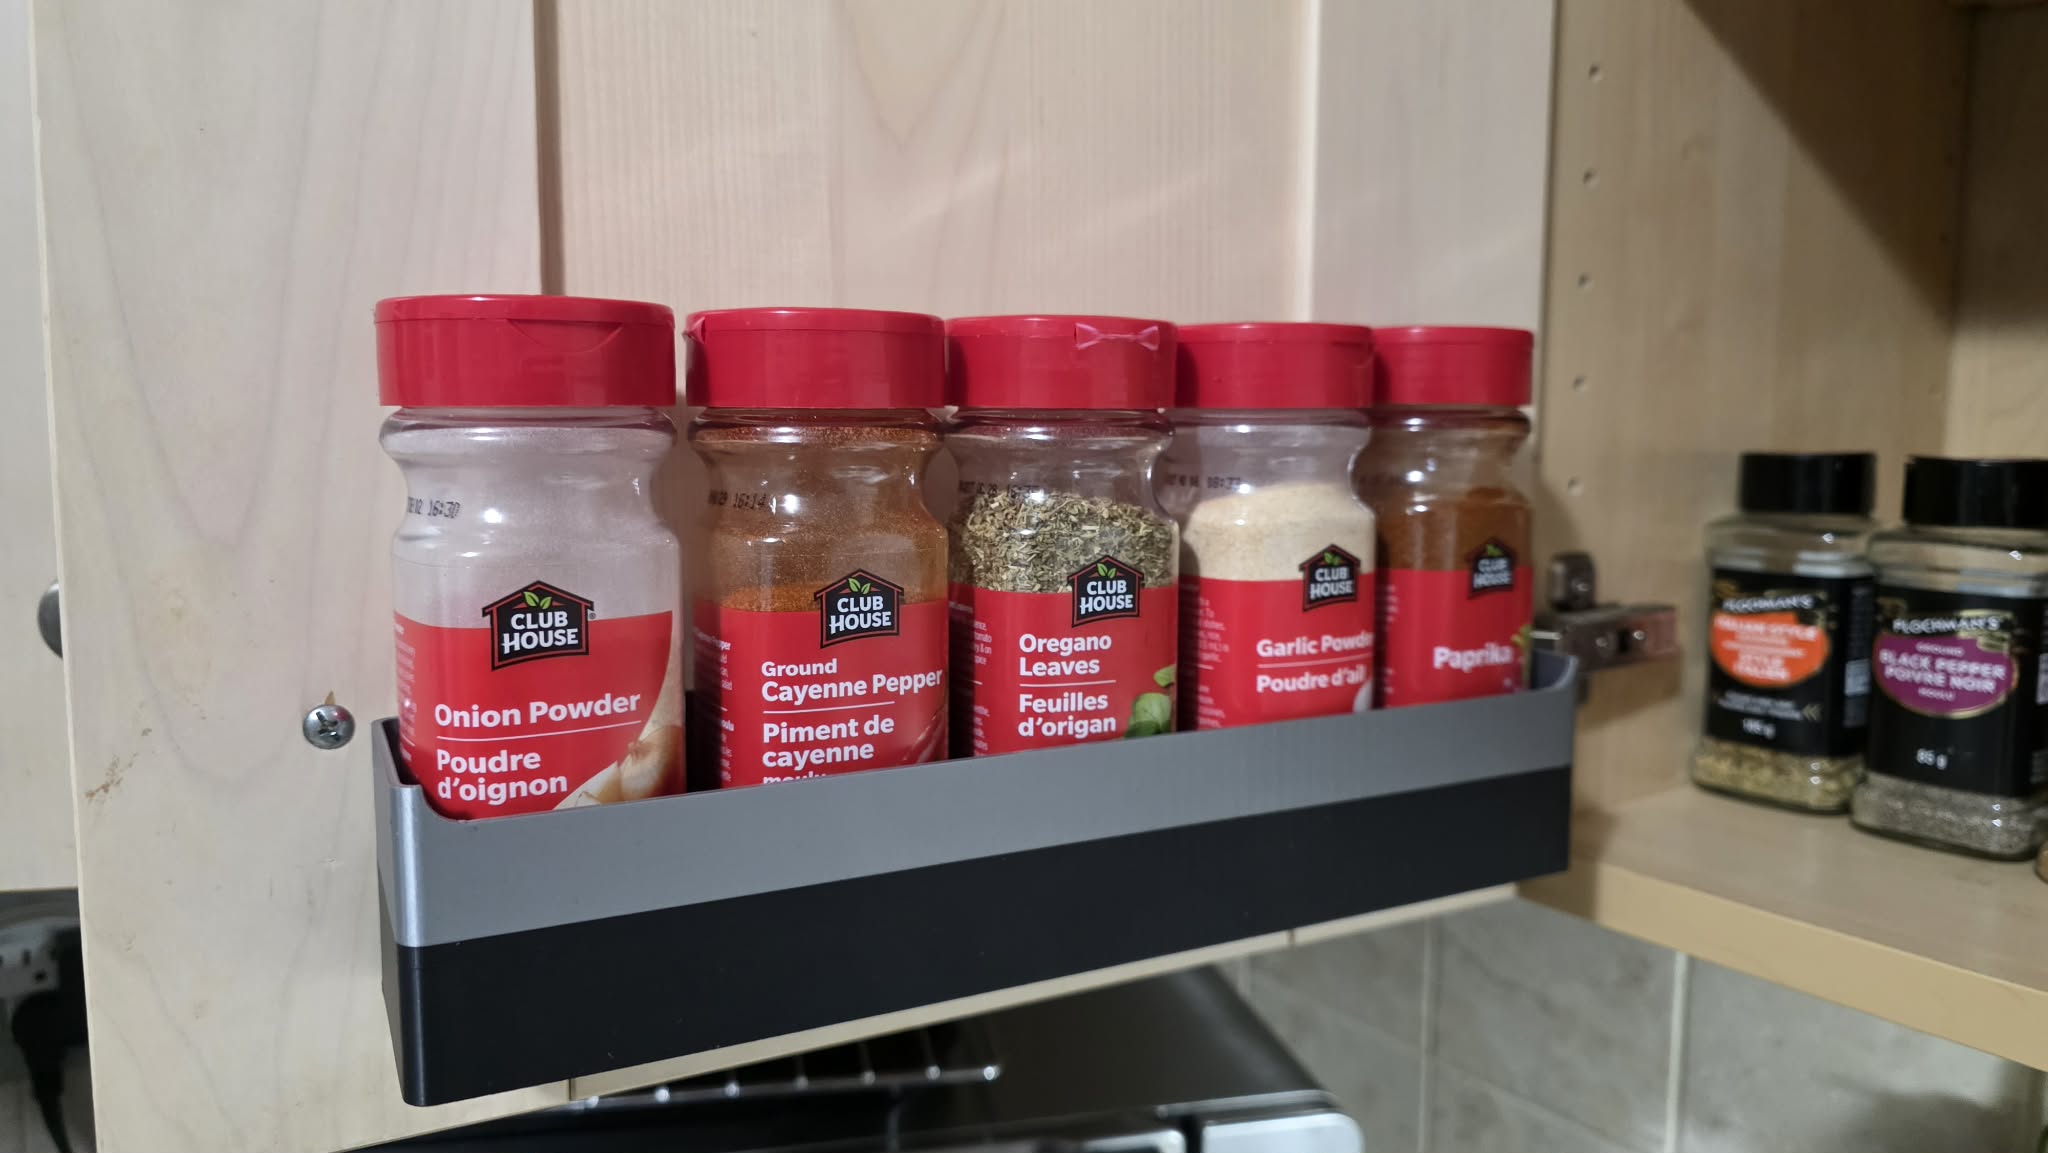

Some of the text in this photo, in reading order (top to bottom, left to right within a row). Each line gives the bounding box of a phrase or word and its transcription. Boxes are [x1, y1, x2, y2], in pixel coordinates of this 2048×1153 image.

[1314, 567, 1348, 582] CLUB
[1477, 557, 1508, 572] CLUB
[1086, 579, 1127, 595] CLUB
[1309, 581, 1353, 601] HOUSE
[1473, 572, 1512, 589] HOUSE
[836, 595, 884, 613] CLUB
[1079, 594, 1134, 615] HOUSE
[510, 611, 569, 631] CLUB
[829, 611, 892, 634] HOUSE
[501, 628, 579, 655] HOUSE
[1018, 633, 1112, 657] Oregano
[1256, 636, 1319, 658] Garlic
[761, 658, 838, 677] Ground
[1019, 657, 1100, 677] Leaves
[1433, 642, 1513, 673] Paprika
[1878, 648, 2007, 681] BLACK PEPPER
[761, 669, 943, 706] Cayenne Pepper
[1256, 672, 1329, 694] Poudre
[1331, 664, 1366, 687] d'ail
[1884, 664, 1947, 688] POIVRE
[1949, 675, 1997, 695] NOIR
[434, 693, 642, 728] Onion Powder
[1018, 691, 1108, 714] Feuilles
[763, 718, 859, 744] Piment
[863, 714, 895, 736] de
[1017, 715, 1117, 739] d'origan
[436, 749, 542, 774] Poudre
[762, 743, 875, 771] cayenne
[437, 774, 568, 806] d'oignon
